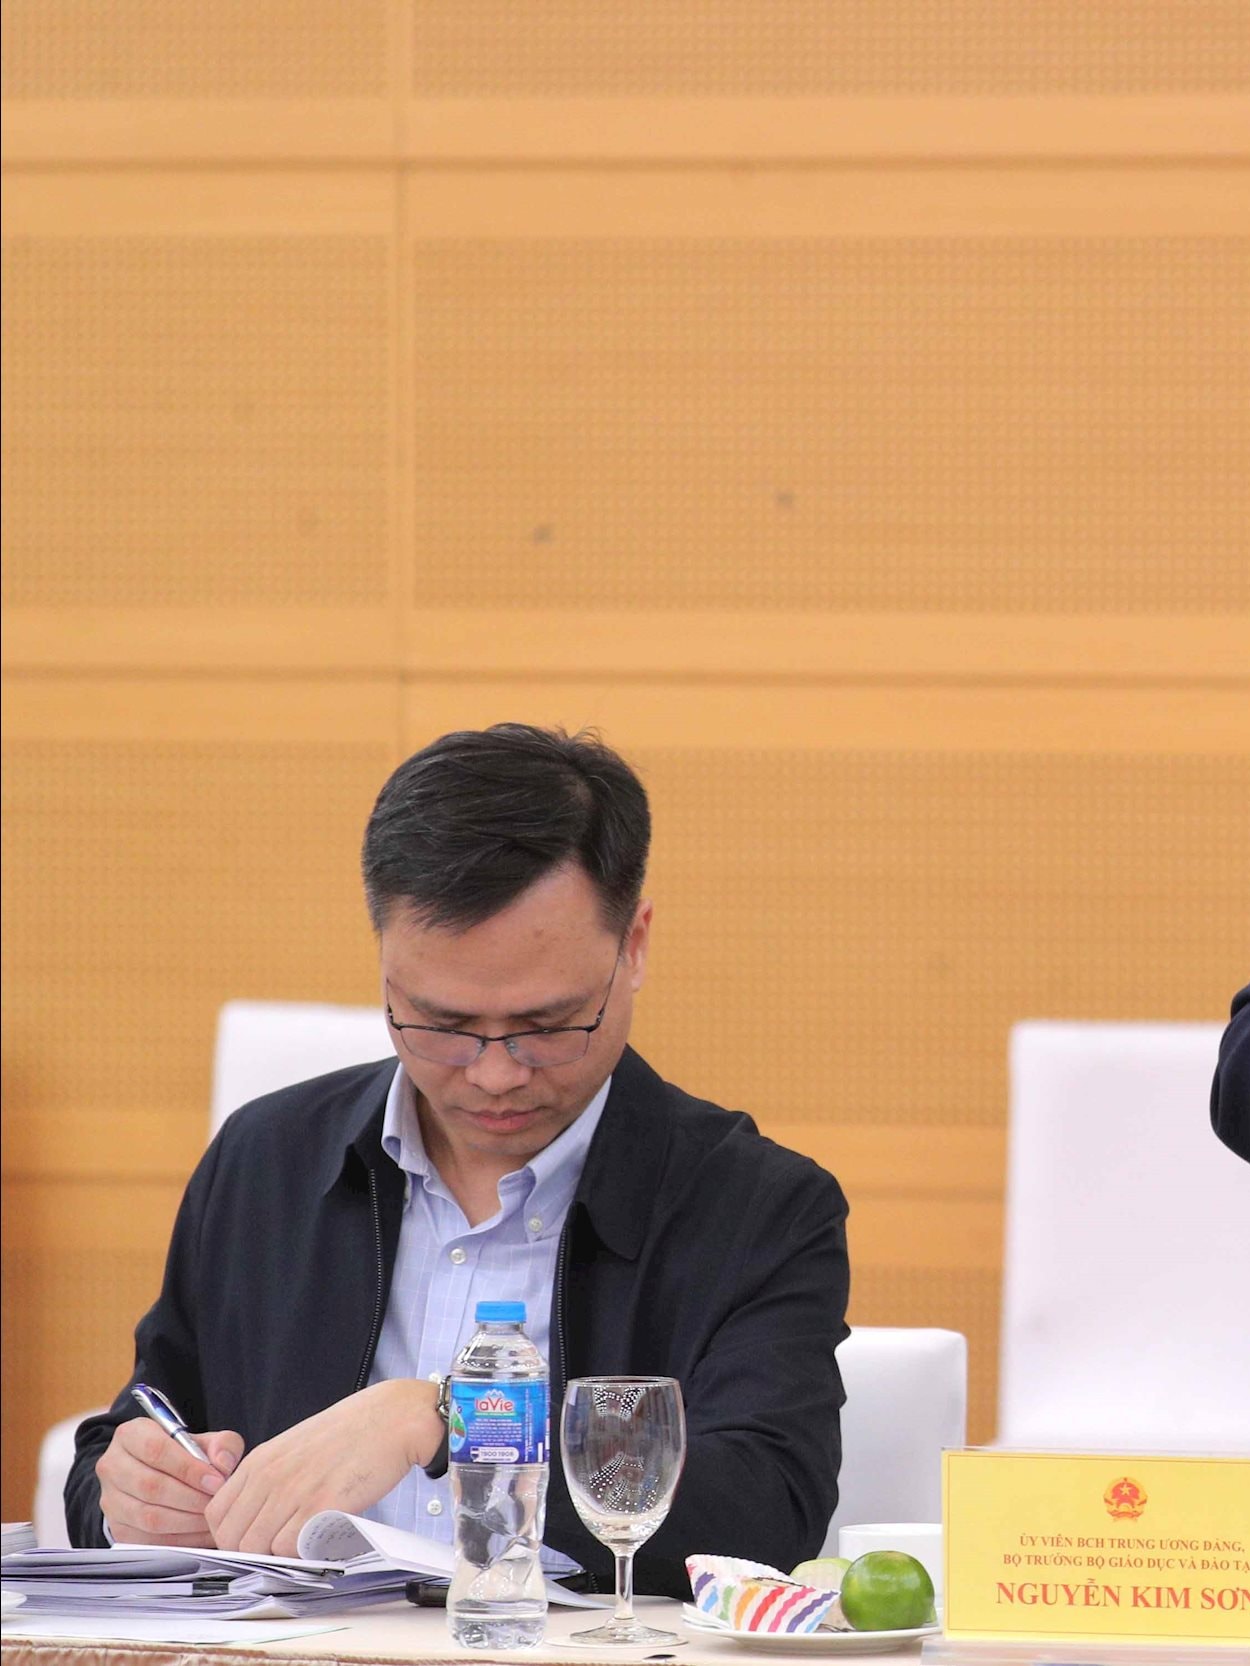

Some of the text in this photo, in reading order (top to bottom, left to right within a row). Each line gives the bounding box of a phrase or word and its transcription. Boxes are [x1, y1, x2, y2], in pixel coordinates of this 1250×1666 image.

[1041, 1534, 1073, 1548] VIÊN
[1077, 1537, 1104, 1548] BCH
[1108, 1538, 1156, 1550] TRUNG
[1160, 1538, 1199, 1551] ƯƠNG
[1003, 1553, 1022, 1567] BỘ
[1024, 1553, 1082, 1567] TRƯỞNG
[1086, 1555, 1105, 1569] BỘ
[1108, 1554, 1143, 1569] GIÁO
[1147, 1557, 1175, 1571] DỤC
[1178, 1556, 1197, 1570] VÀ
[1201, 1557, 1230, 1571] ĐÀO
[995, 1578, 1122, 1608] NGUYỄN
[1131, 1586, 1192, 1609] KIM
